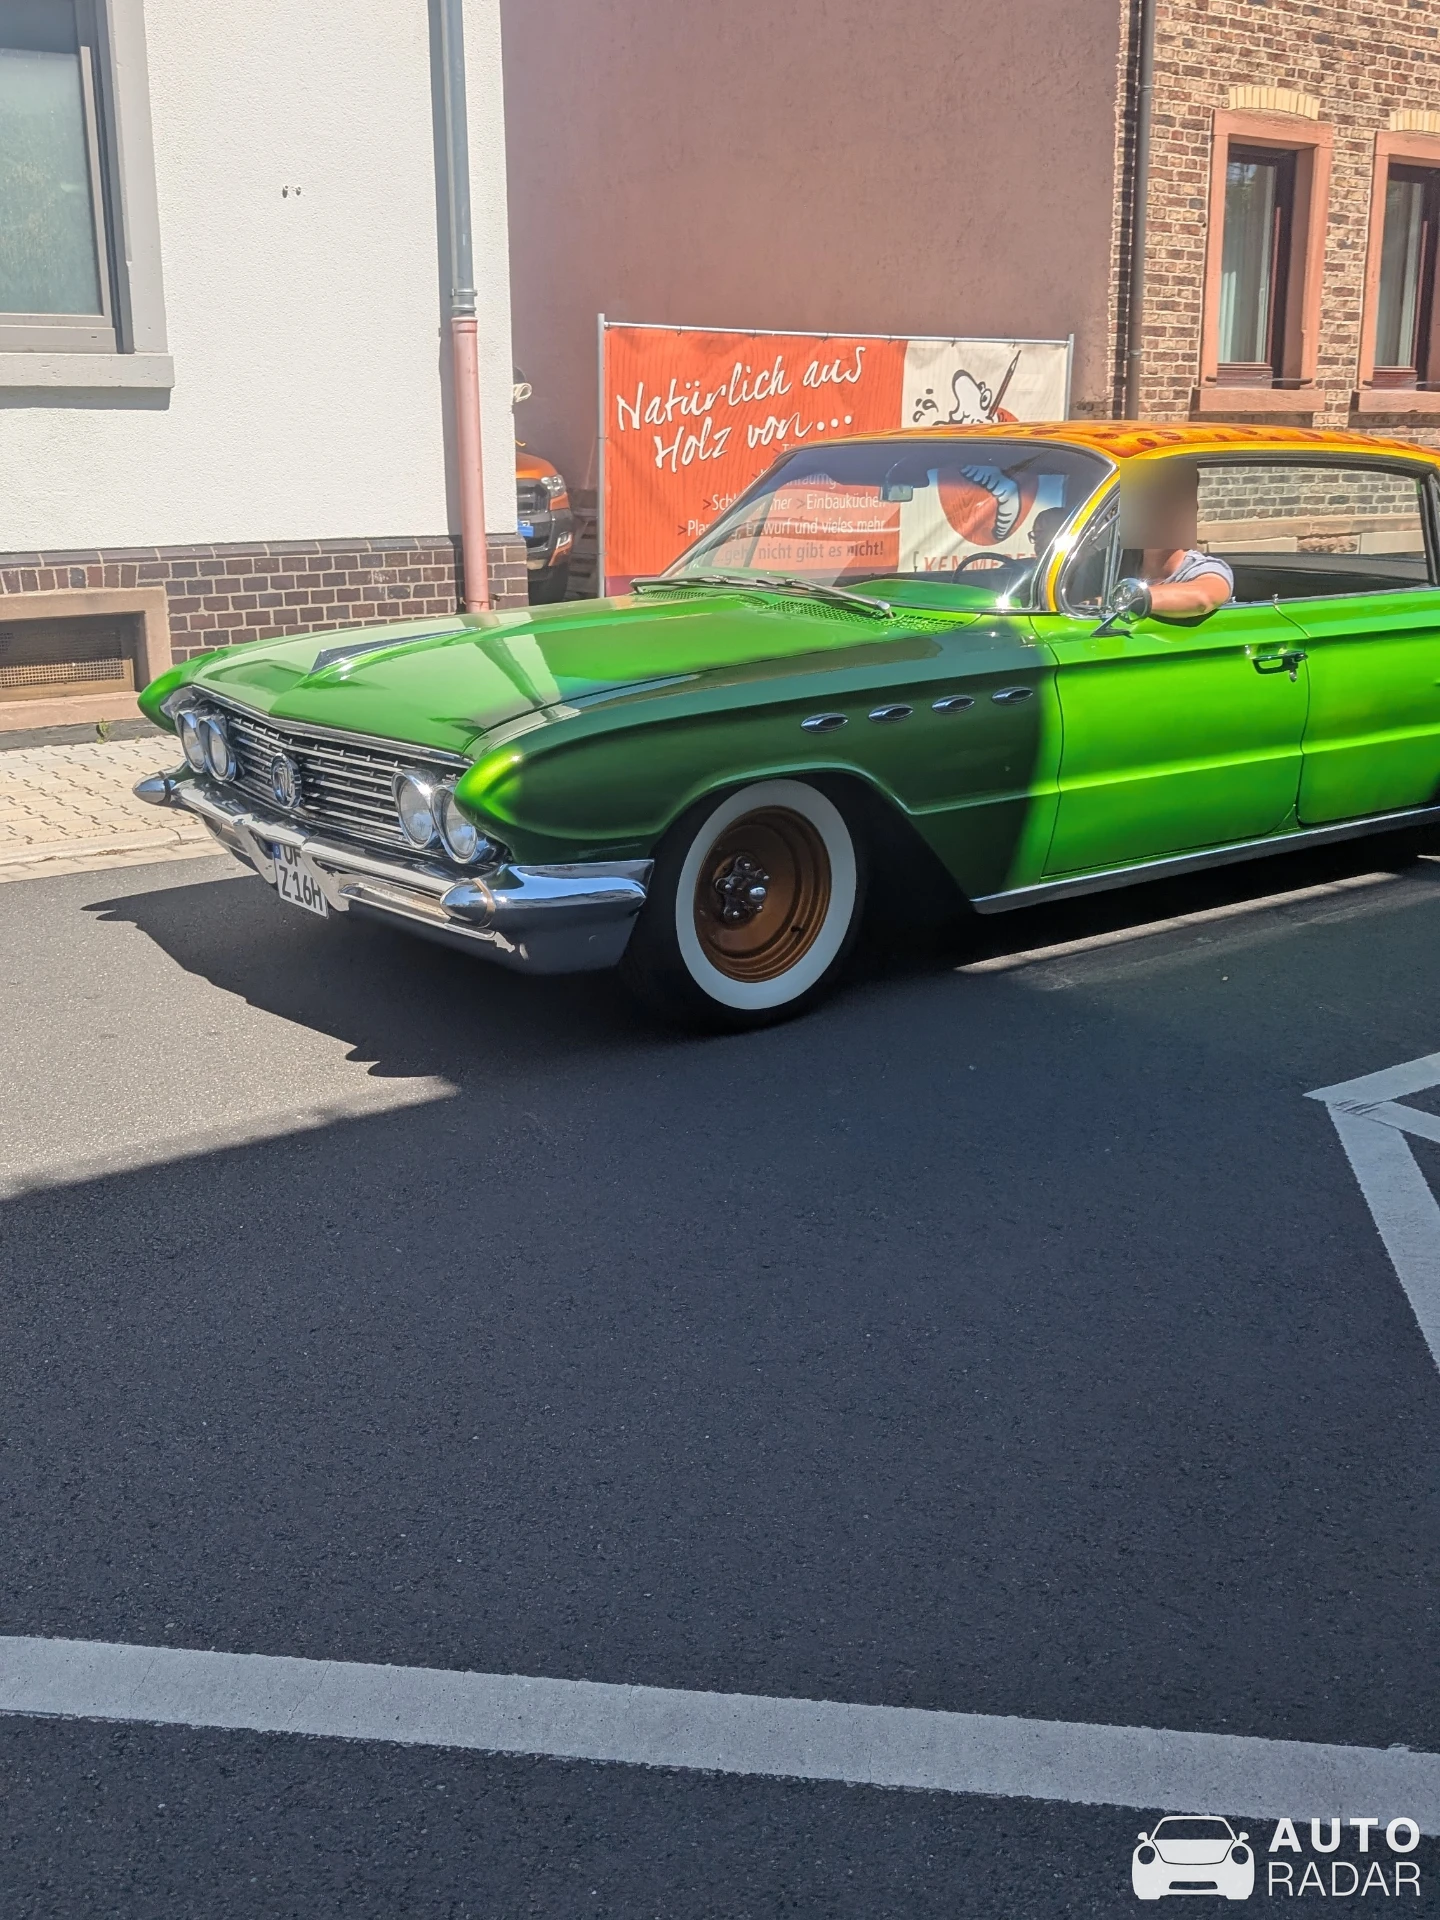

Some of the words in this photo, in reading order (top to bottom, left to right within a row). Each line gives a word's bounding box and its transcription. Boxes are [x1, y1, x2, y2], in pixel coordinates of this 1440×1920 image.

[616, 355, 792, 431] Natürlich
[803, 346, 866, 388] aus
[654, 416, 732, 473] Holz
[795, 516, 817, 534] und
[822, 516, 853, 534] vieles
[857, 515, 885, 532] mehr
[758, 542, 791, 560] nicht
[796, 541, 824, 563] gibt
[829, 545, 842, 557] es
